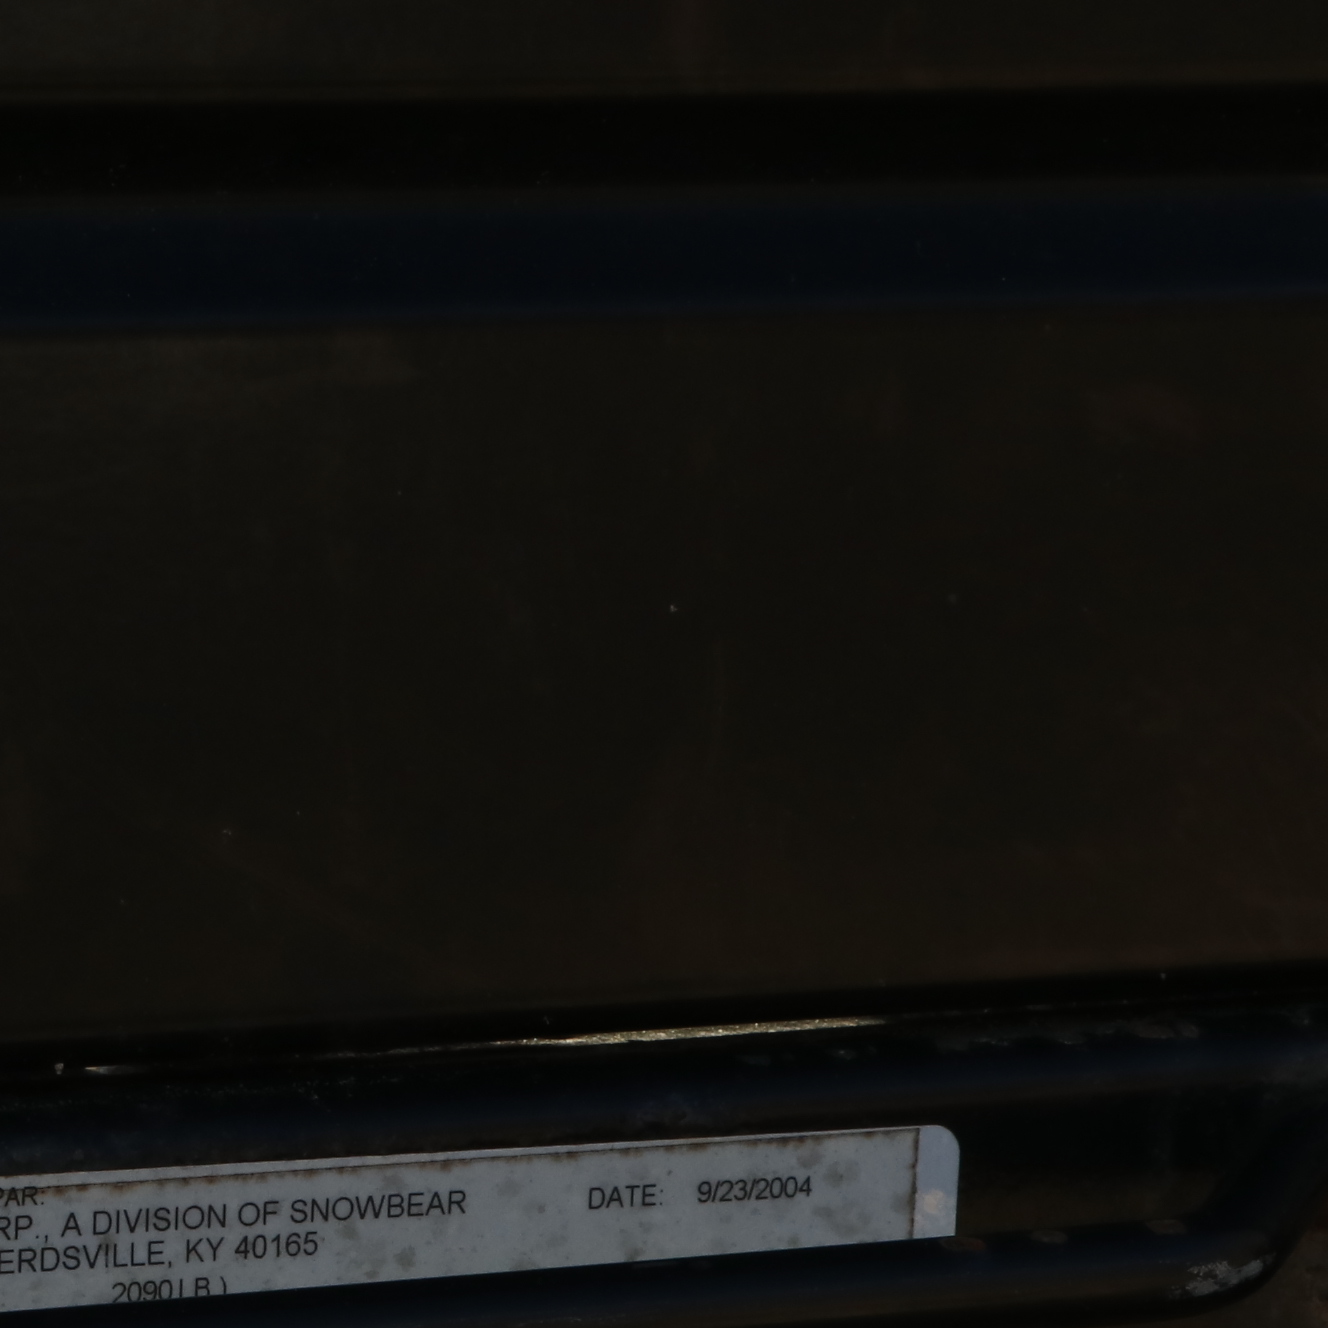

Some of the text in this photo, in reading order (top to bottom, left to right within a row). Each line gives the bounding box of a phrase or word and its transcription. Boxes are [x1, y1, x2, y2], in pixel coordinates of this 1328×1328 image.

[588, 1175, 812, 1210] DATE: 9/23/2004
[60, 1212, 82, 1238] A
[92, 1203, 227, 1236] DIVISION
[237, 1200, 280, 1227] OF
[290, 1190, 467, 1224] SNOWBEAR
[186, 1237, 224, 1263] KY
[234, 1231, 318, 1260] 40165
